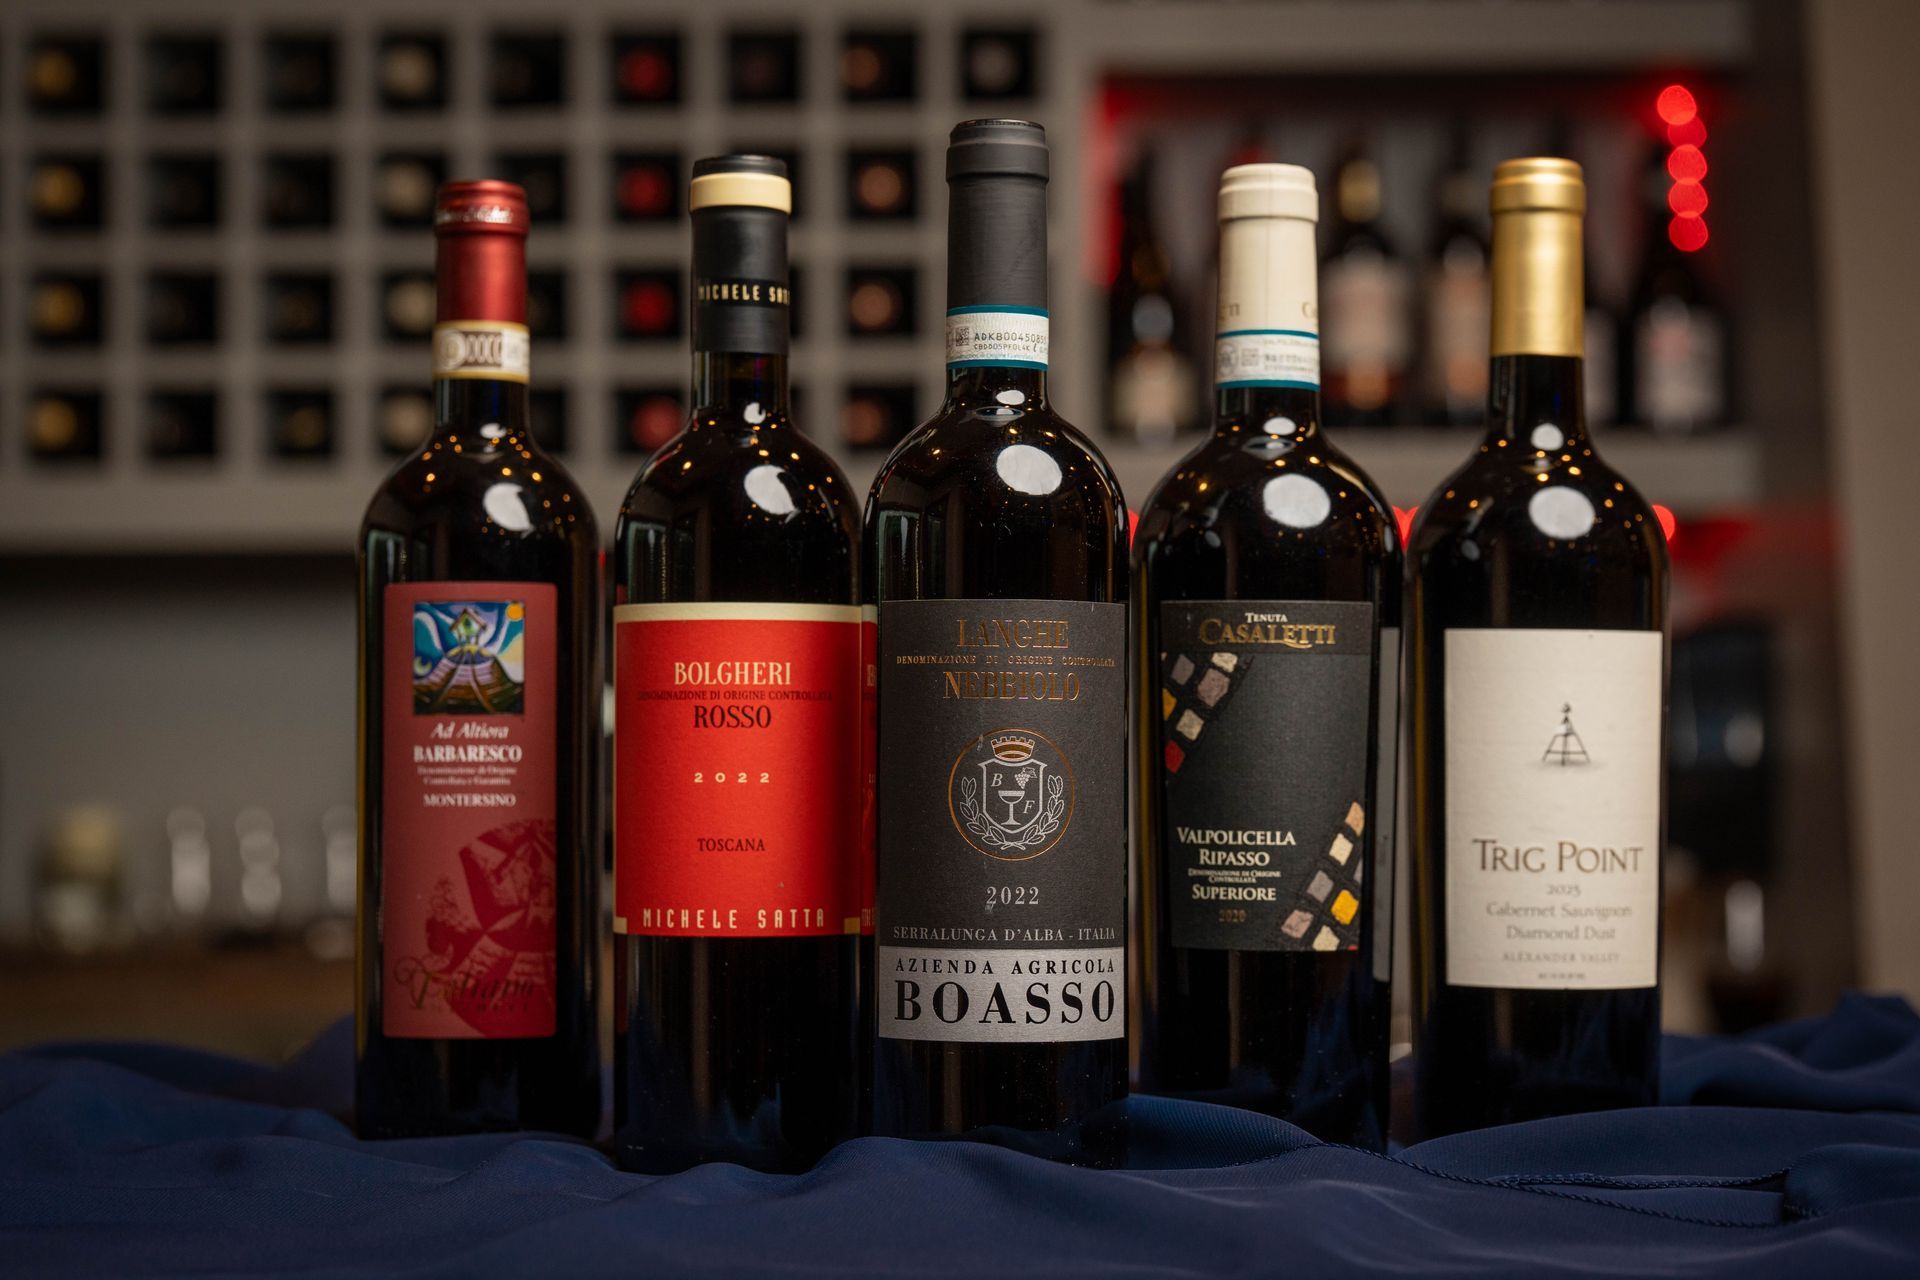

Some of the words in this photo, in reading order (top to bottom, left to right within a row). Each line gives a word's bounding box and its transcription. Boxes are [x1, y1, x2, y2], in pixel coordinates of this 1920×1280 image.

[698, 283, 760, 301] MICHELE
[1245, 612, 1288, 623] TENUTA
[956, 619, 1069, 649] LANGHE
[1200, 619, 1336, 649] CASALETTI
[896, 655, 976, 665] DENOMINAZIONE
[986, 656, 998, 665] DI
[1007, 655, 1053, 665] ORIGINE
[674, 662, 792, 685] BOLGHERI
[943, 671, 1081, 701] NEBBIOLO
[709, 690, 721, 701] DI
[723, 690, 766, 701] ORIGINE
[693, 705, 772, 728] ROSSO
[431, 721, 455, 738] Ad
[414, 745, 522, 762] BARBARESCO
[693, 772, 770, 784] 2022
[991, 773, 1003, 787] B
[423, 793, 516, 807] MONTERSINO
[1023, 800, 1035, 814] F
[697, 838, 766, 852] TOSCANA
[1177, 827, 1296, 846] VALPOLICELLA
[1199, 849, 1270, 867] RIPASSO
[986, 886, 1040, 905] 2022
[1192, 883, 1276, 901] SUPERIORE
[643, 909, 738, 929] MICHELE
[757, 908, 825, 928] SATTA
[1486, 901, 1555, 918] Cabernet
[1561, 903, 1632, 921] Sauvignon
[893, 926, 997, 941] SERRALUNGA
[1005, 927, 1064, 941] D'ALBA
[1078, 927, 1115, 940] ITALIA
[1506, 925, 1580, 939] Diamond
[1584, 925, 1615, 939] Dust
[895, 958, 994, 974] AZIENDA
[1011, 958, 1114, 975] AGRICOLA
[894, 980, 1115, 1024] BOASSO
